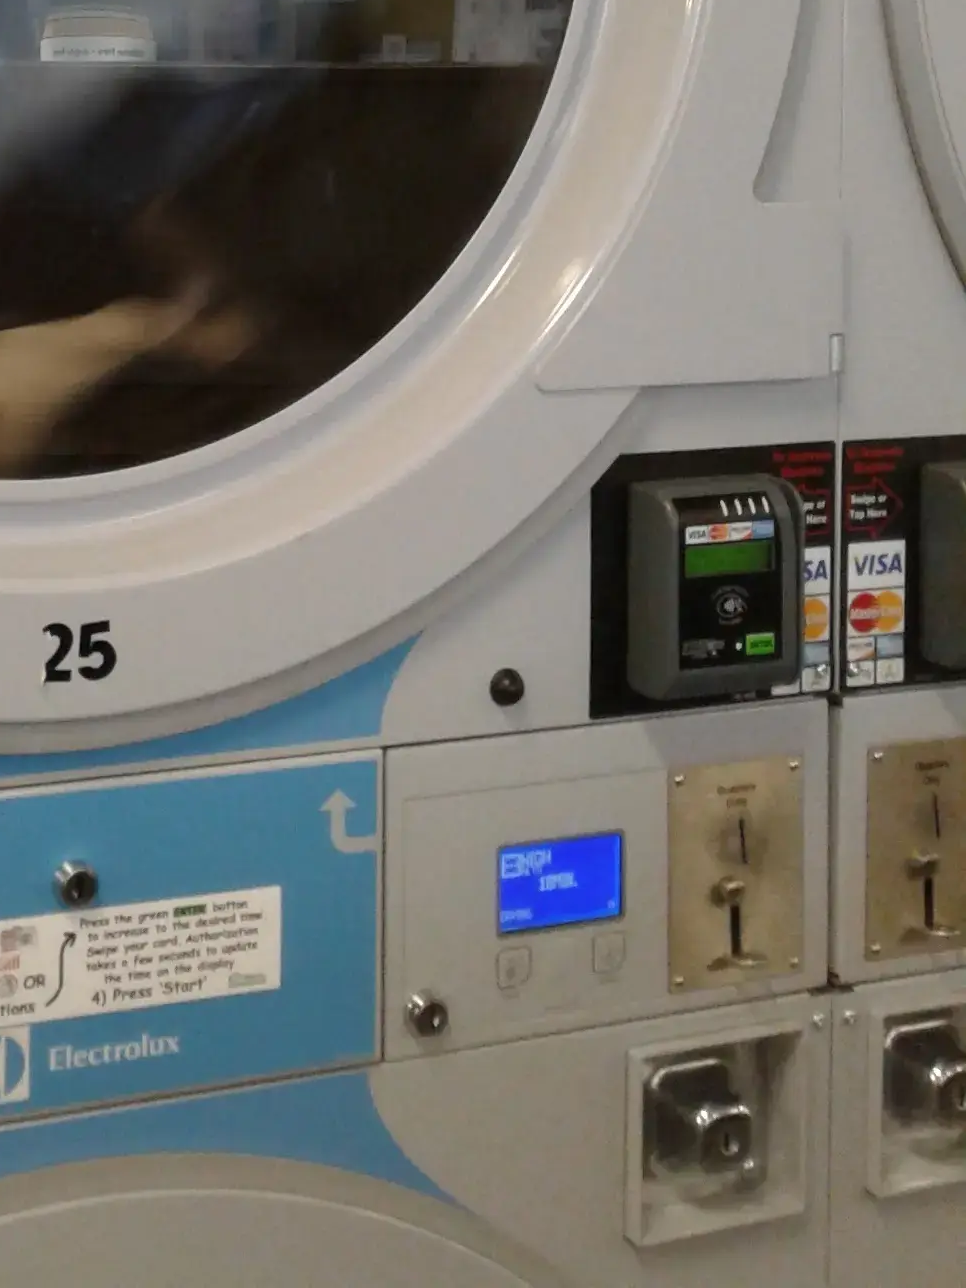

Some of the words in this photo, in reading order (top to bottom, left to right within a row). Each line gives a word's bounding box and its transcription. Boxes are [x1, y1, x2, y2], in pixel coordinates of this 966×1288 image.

[806, 515, 827, 524] Here
[689, 529, 707, 539] VISA
[803, 560, 828, 580] SA
[854, 553, 903, 576] VISA
[42, 619, 117, 683] 25
[80, 916, 109, 928] Press
[114, 913, 132, 924] the
[138, 910, 168, 924] green
[213, 900, 248, 912] button
[88, 932, 99, 942] to
[104, 926, 149, 939] increase
[156, 923, 167, 933] to
[173, 919, 190, 930] the
[195, 914, 236, 928] desired
[87, 945, 118, 958] Swipe
[123, 941, 148, 955] your
[186, 927, 259, 944] Authorization
[86, 960, 116, 972] takes
[121, 959, 129, 968] a
[133, 954, 154, 966] few
[158, 947, 202, 963] seconds
[206, 945, 218, 956] to
[221, 941, 258, 956] update
[23, 974, 46, 990] OR
[104, 972, 122, 984] the
[156, 967, 170, 978] on
[174, 963, 193, 974] the
[197, 959, 235, 973] display
[91, 991, 107, 1007] 4)
[112, 985, 153, 1003] Press
[48, 1031, 180, 1072] Electrolux
